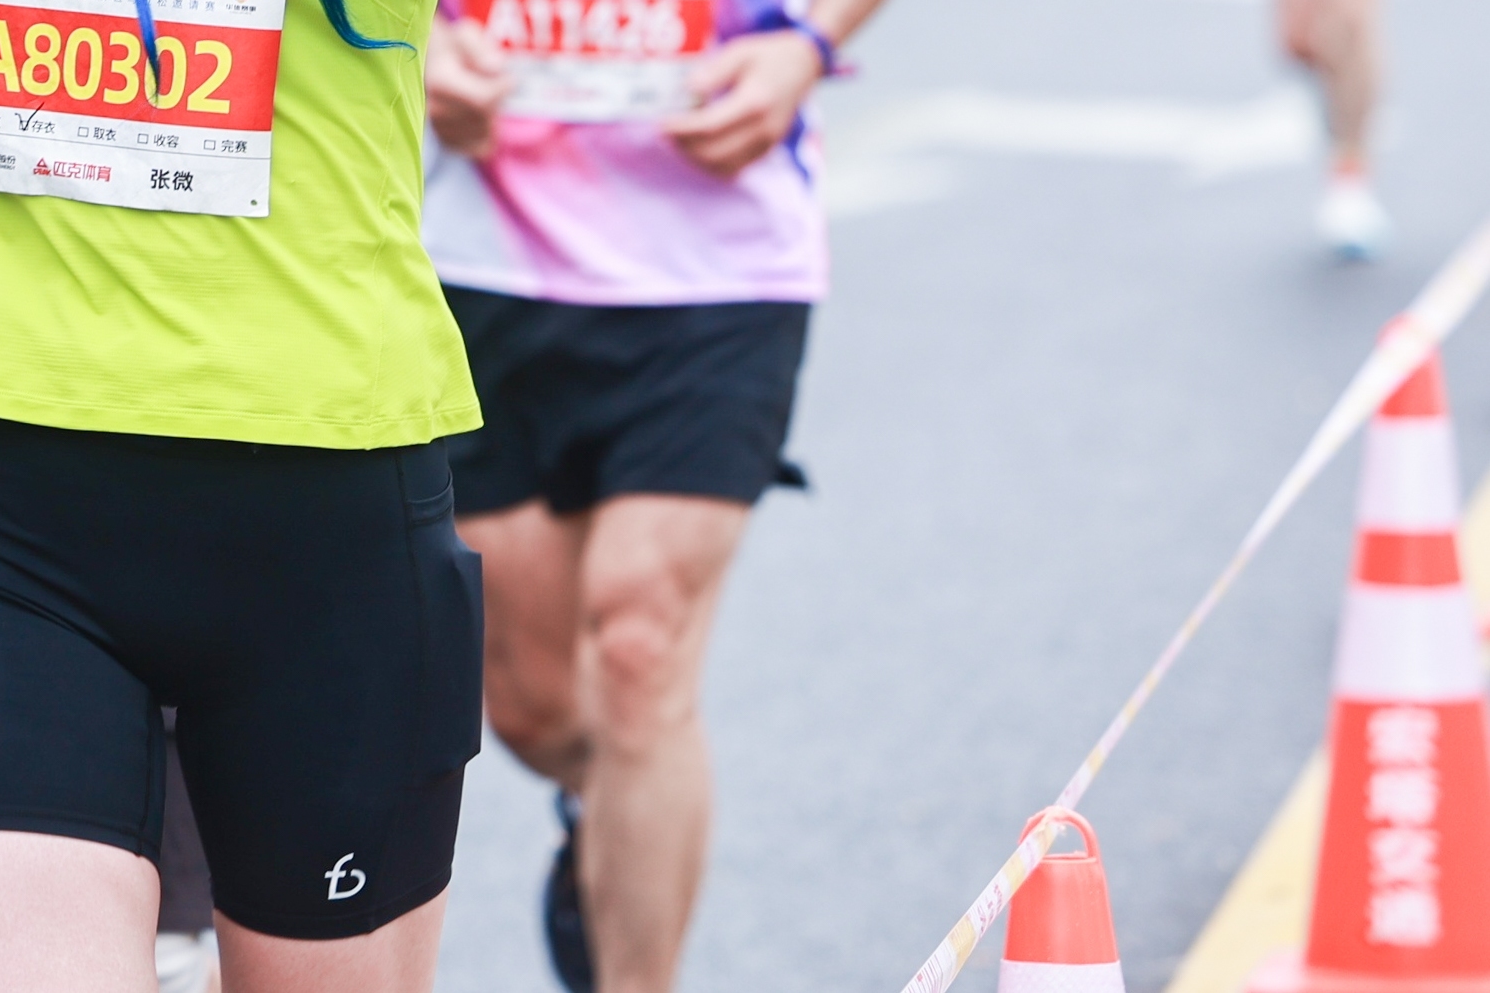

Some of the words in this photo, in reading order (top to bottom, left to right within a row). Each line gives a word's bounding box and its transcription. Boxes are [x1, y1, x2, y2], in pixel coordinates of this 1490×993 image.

[93, 127, 117, 142] 取衣
[153, 133, 180, 148] 收容
[221, 139, 248, 154] 完赛
[53, 160, 113, 183] 匹克体育
[150, 168, 195, 193] 张微
